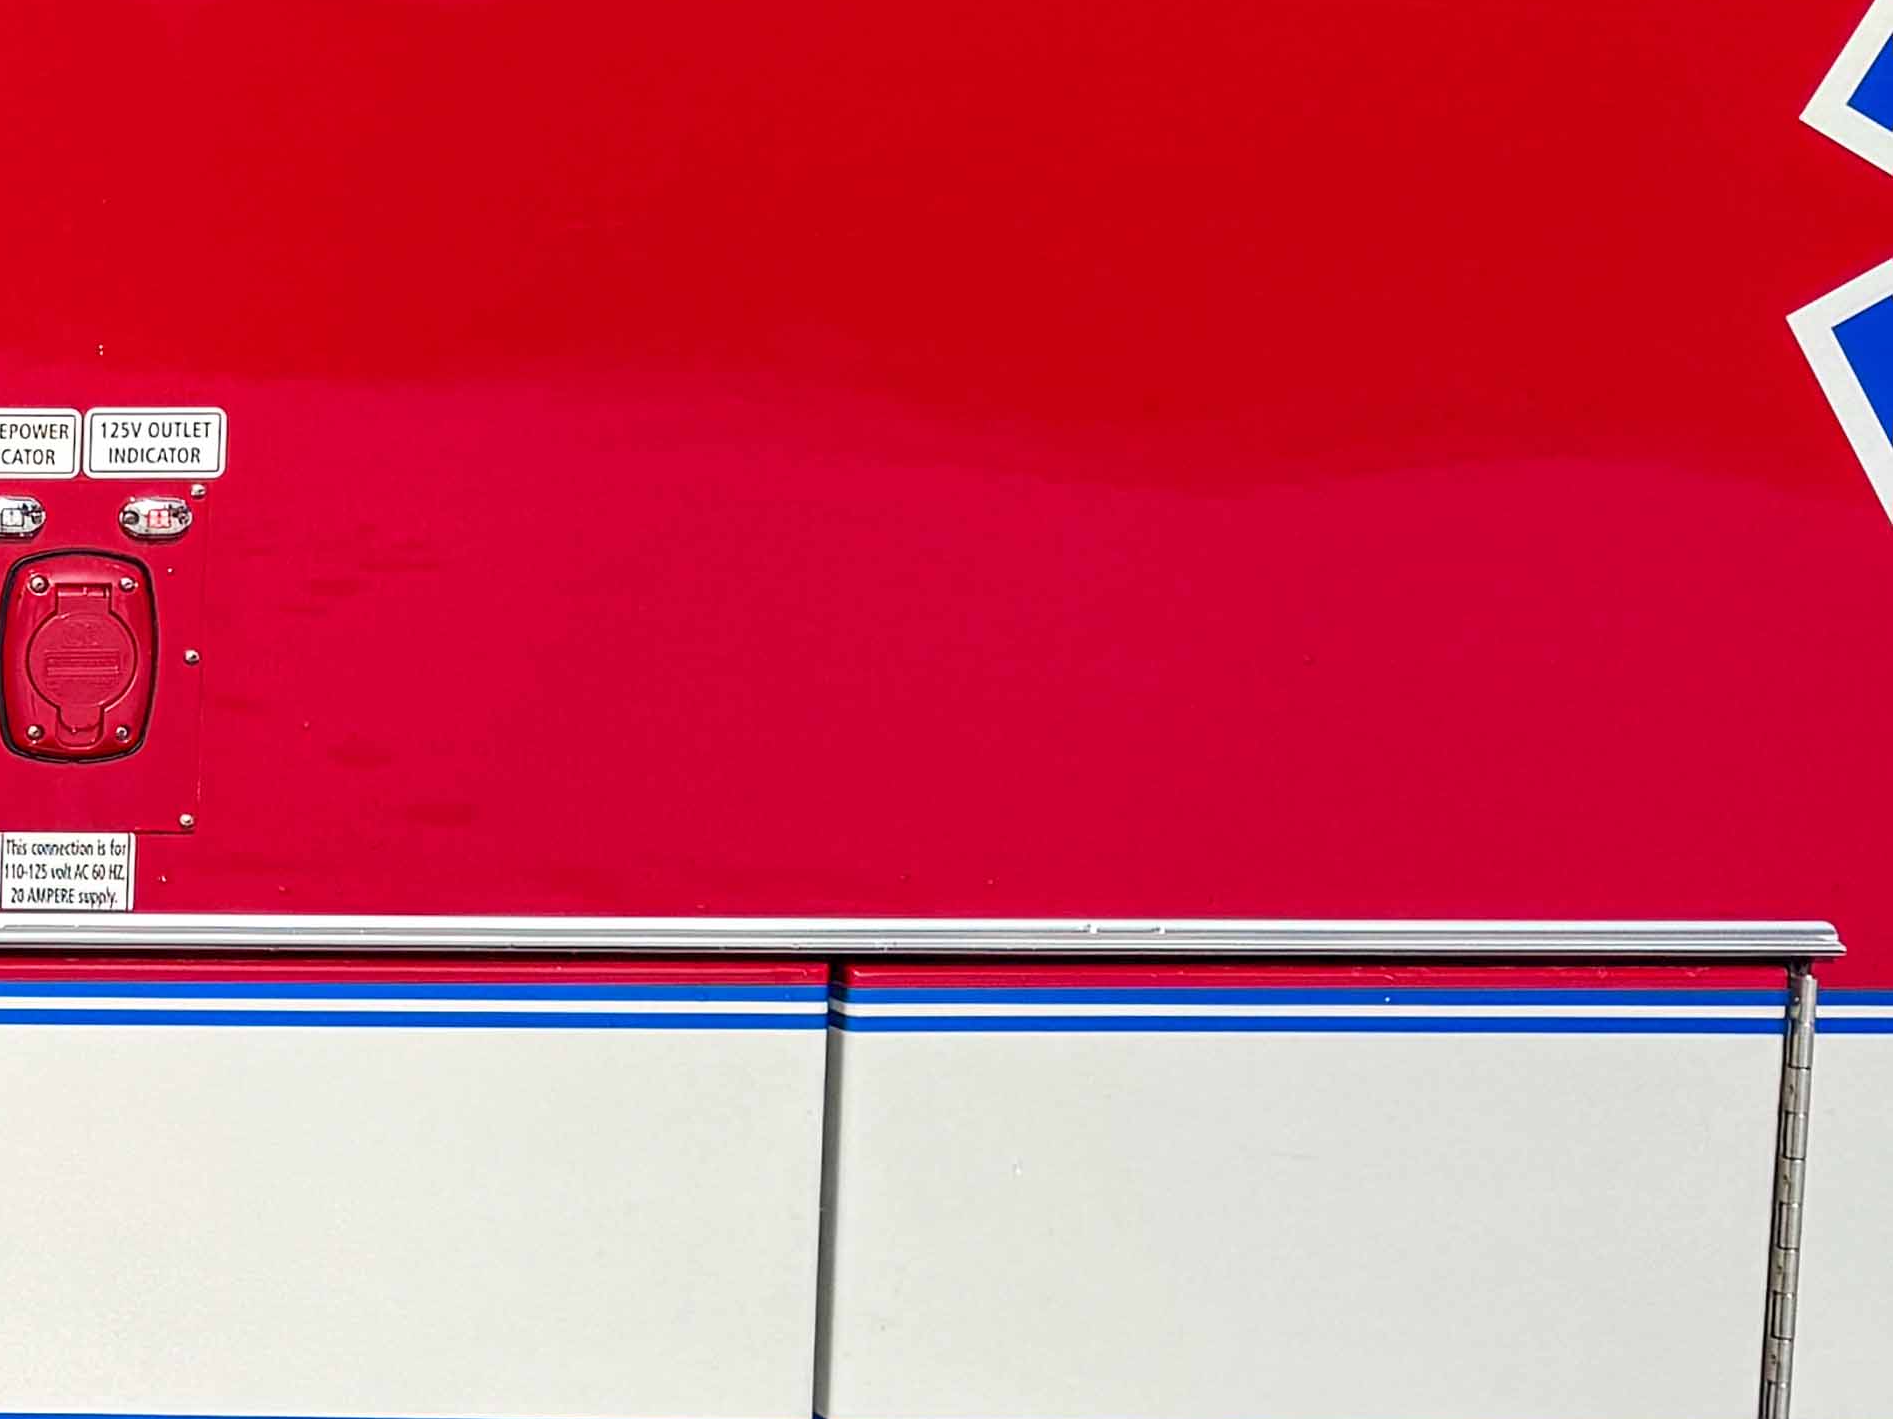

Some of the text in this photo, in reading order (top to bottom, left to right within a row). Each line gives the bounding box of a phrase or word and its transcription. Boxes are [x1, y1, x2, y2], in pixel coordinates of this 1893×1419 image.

[100, 421, 212, 439] 125V OUTLET
[108, 446, 201, 465] INDICATOR
[6, 838, 126, 856] This connection is for
[5, 862, 125, 880] 110-125 volt AC 60 HZ
[11, 887, 25, 903] 20
[27, 887, 75, 904] AMPERE
